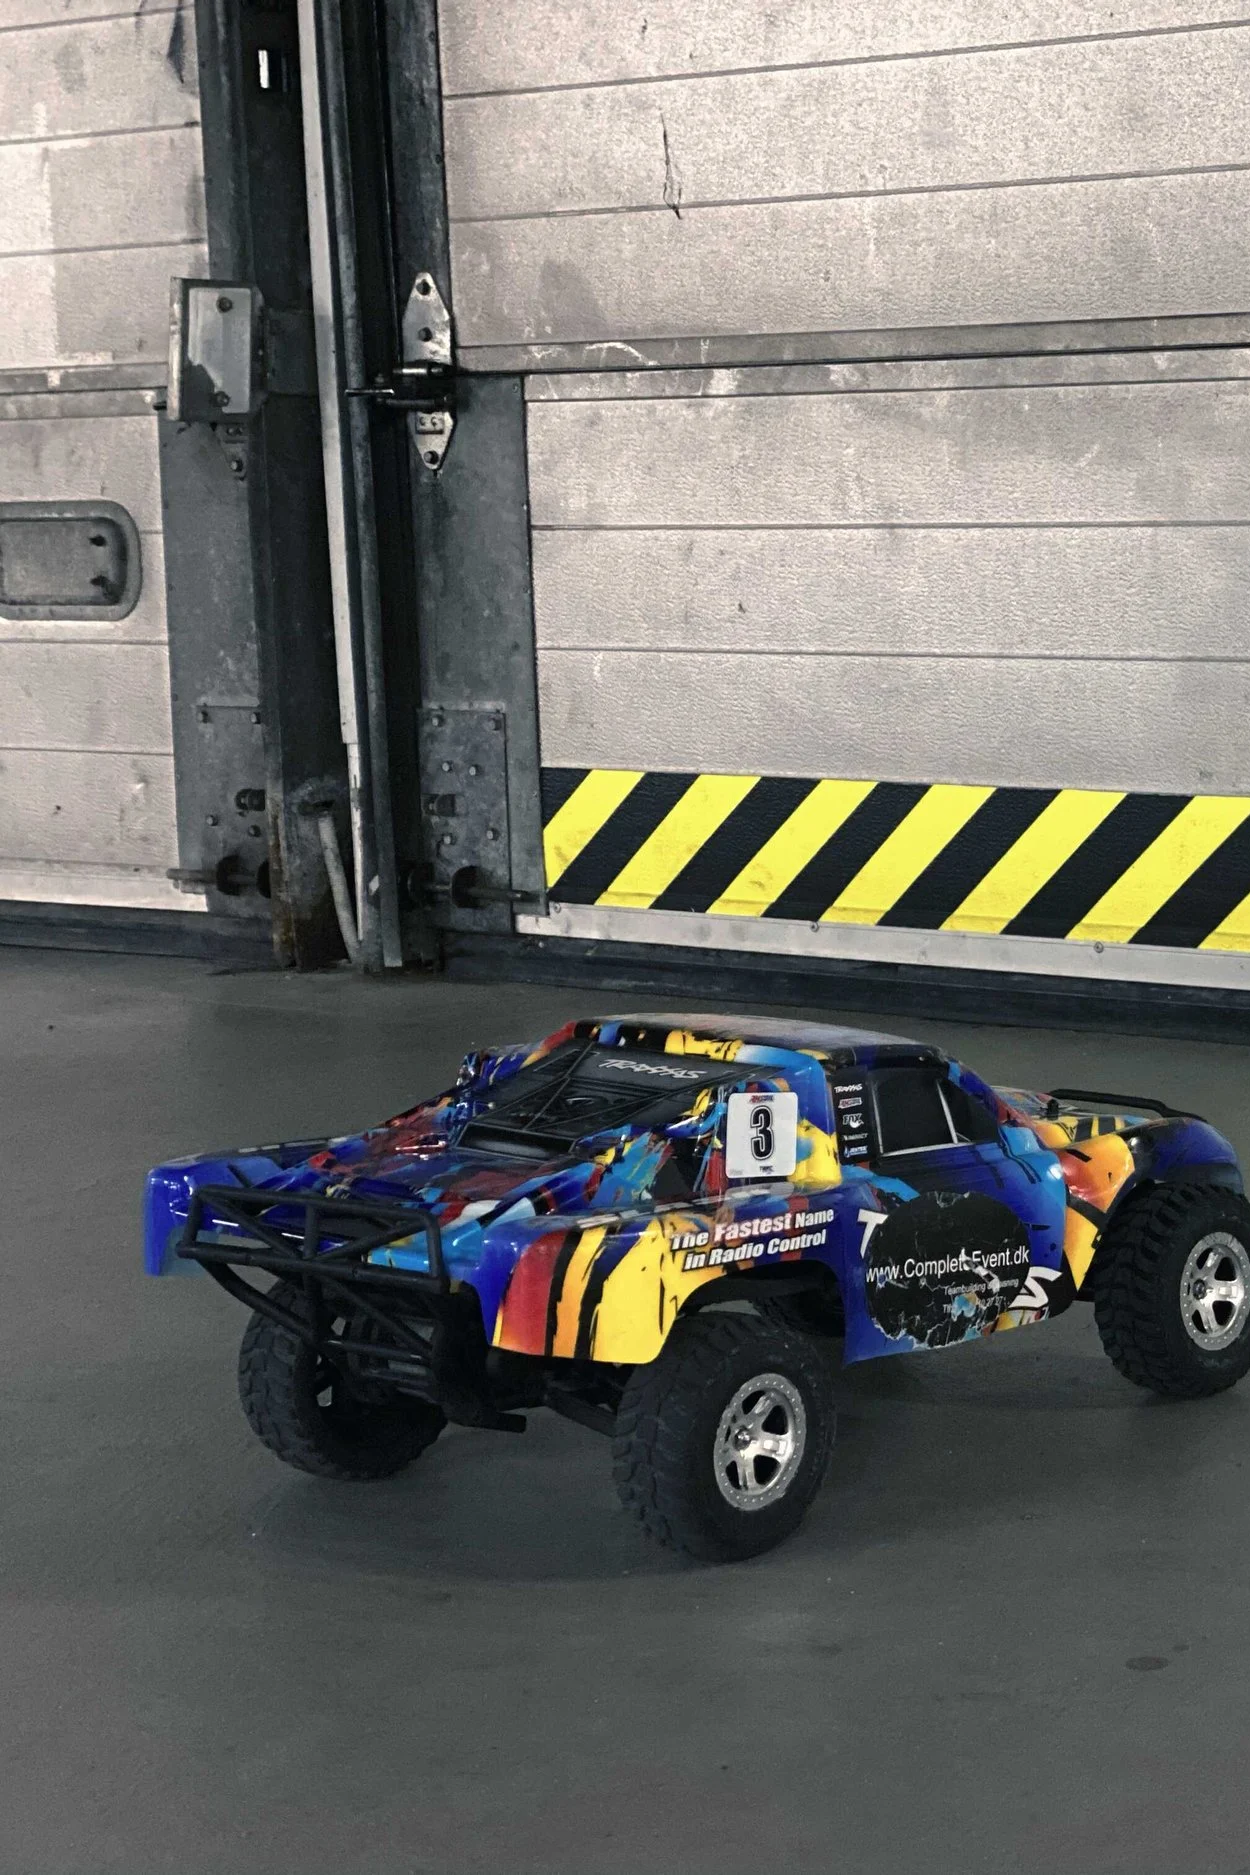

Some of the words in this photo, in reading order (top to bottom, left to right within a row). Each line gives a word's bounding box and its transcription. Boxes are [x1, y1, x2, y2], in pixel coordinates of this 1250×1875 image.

[598, 1059, 707, 1079] TRAXXAS
[750, 1105, 775, 1161] 3
[671, 1231, 709, 1250] The
[714, 1213, 792, 1242] Fastest
[795, 1209, 834, 1228] Name
[684, 1253, 705, 1270] in
[709, 1242, 764, 1265] Radio
[767, 1229, 826, 1254] Control
